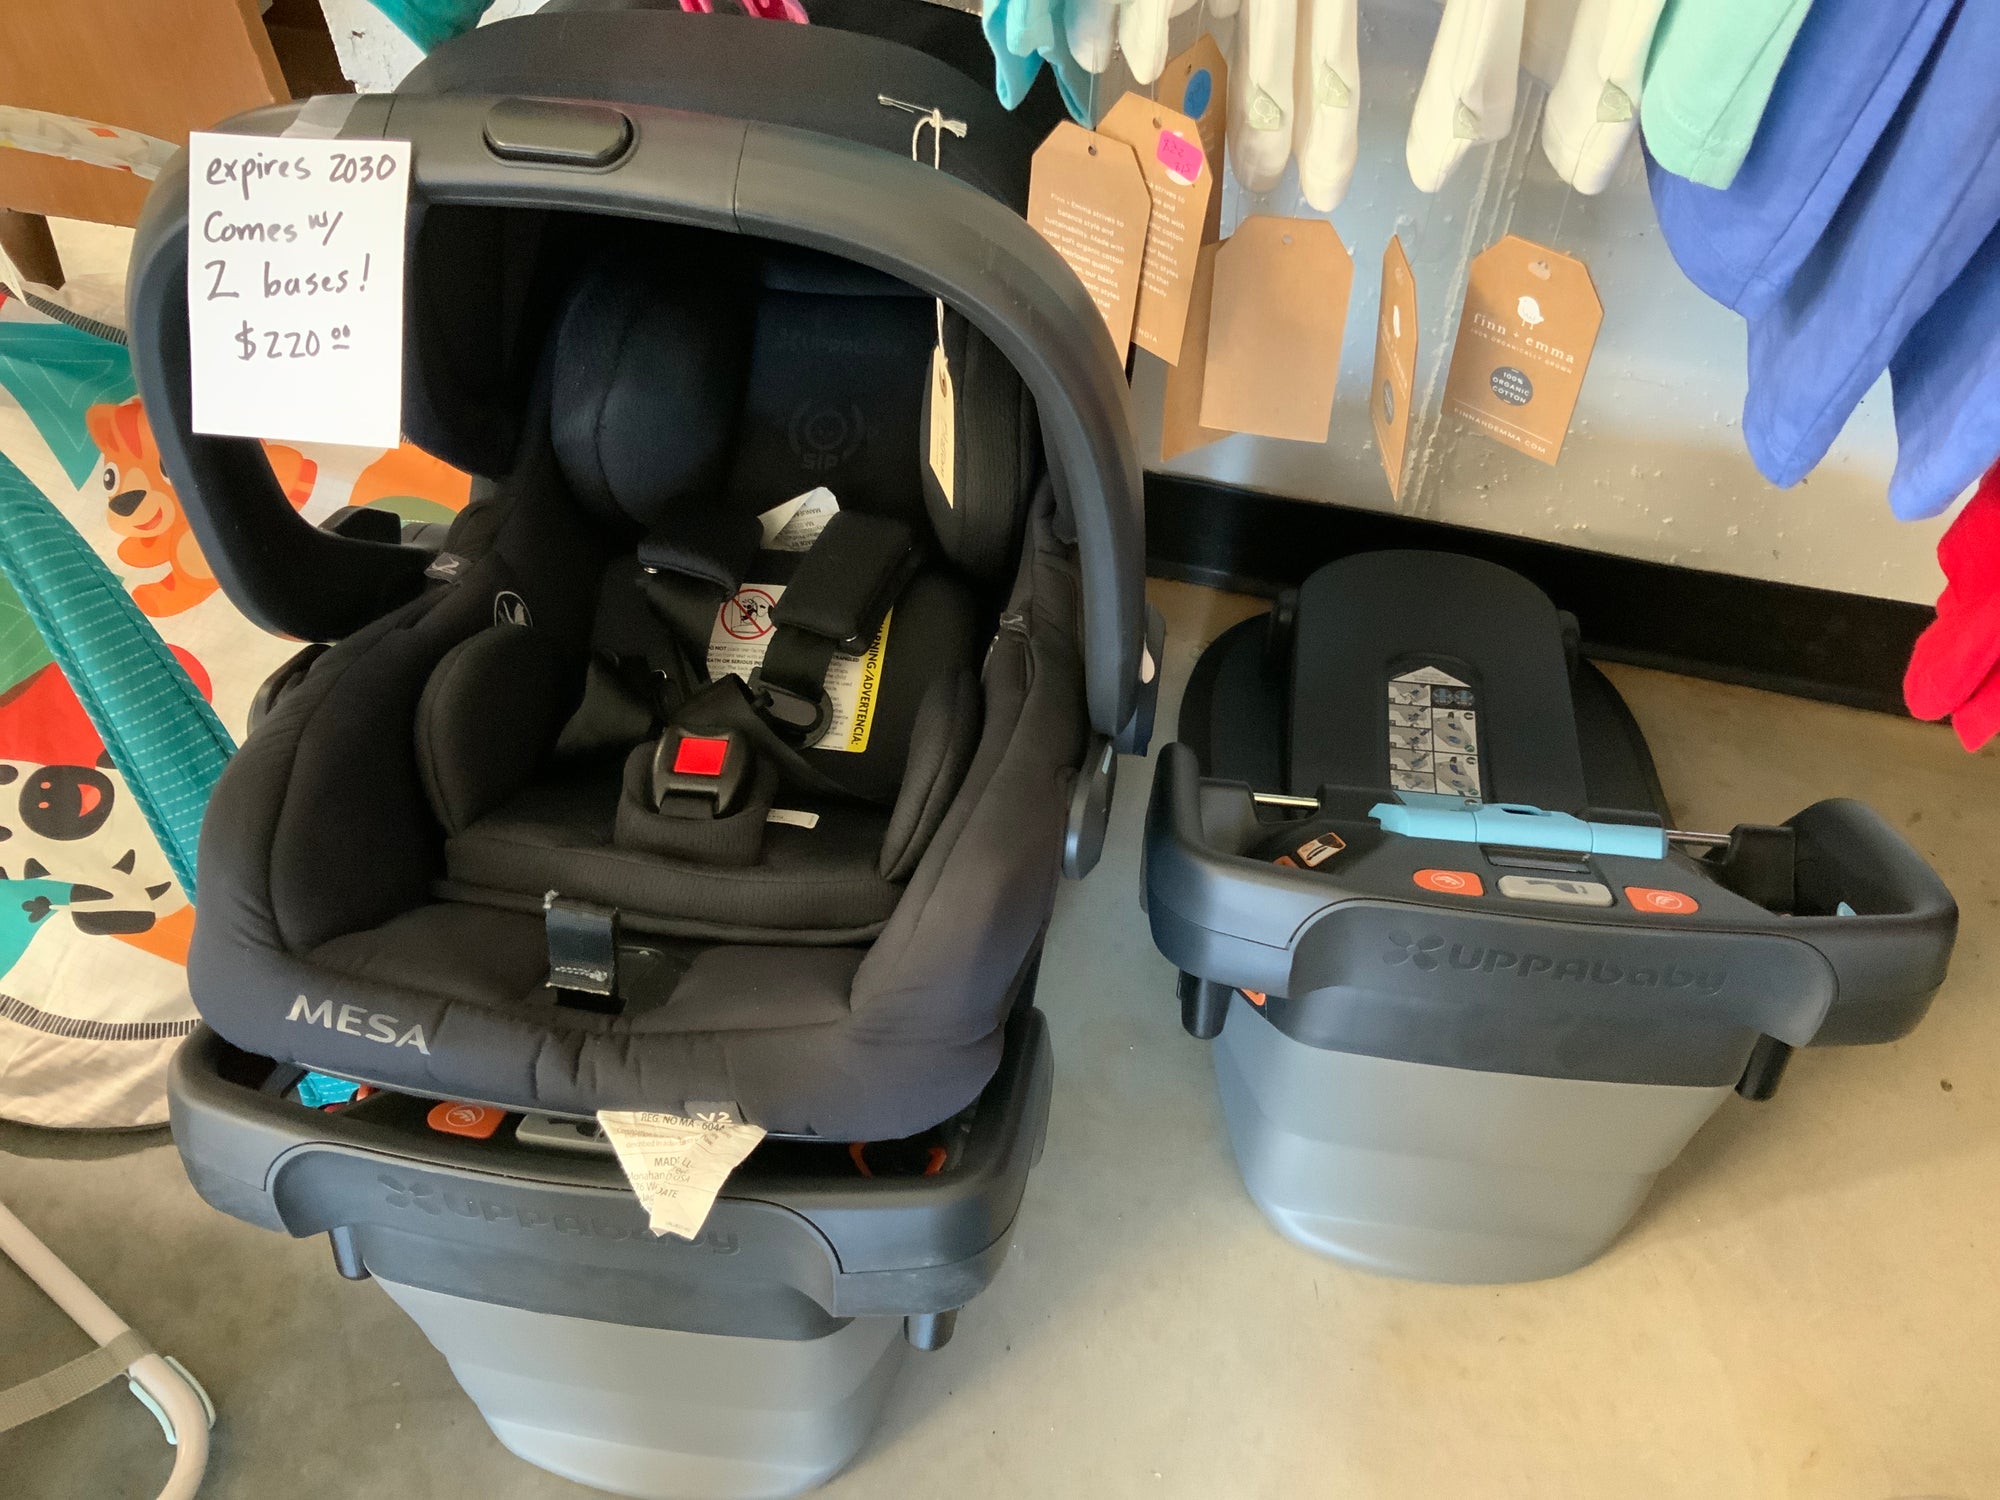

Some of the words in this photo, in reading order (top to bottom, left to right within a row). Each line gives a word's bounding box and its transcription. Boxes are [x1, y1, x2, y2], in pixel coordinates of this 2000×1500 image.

[206, 152, 312, 201] expires
[329, 153, 397, 184] 2030
[203, 210, 299, 244] Comes
[308, 210, 344, 247] w/
[1101, 227, 1115, 237] and
[204, 259, 239, 301] 2
[1473, 312, 1507, 336] finn
[1525, 337, 1575, 364] emma
[1491, 376, 1530, 397] ORGANIC
[1491, 385, 1527, 404] COTTON
[1503, 371, 1524, 386] 100%
[285, 994, 431, 1056] MESA
